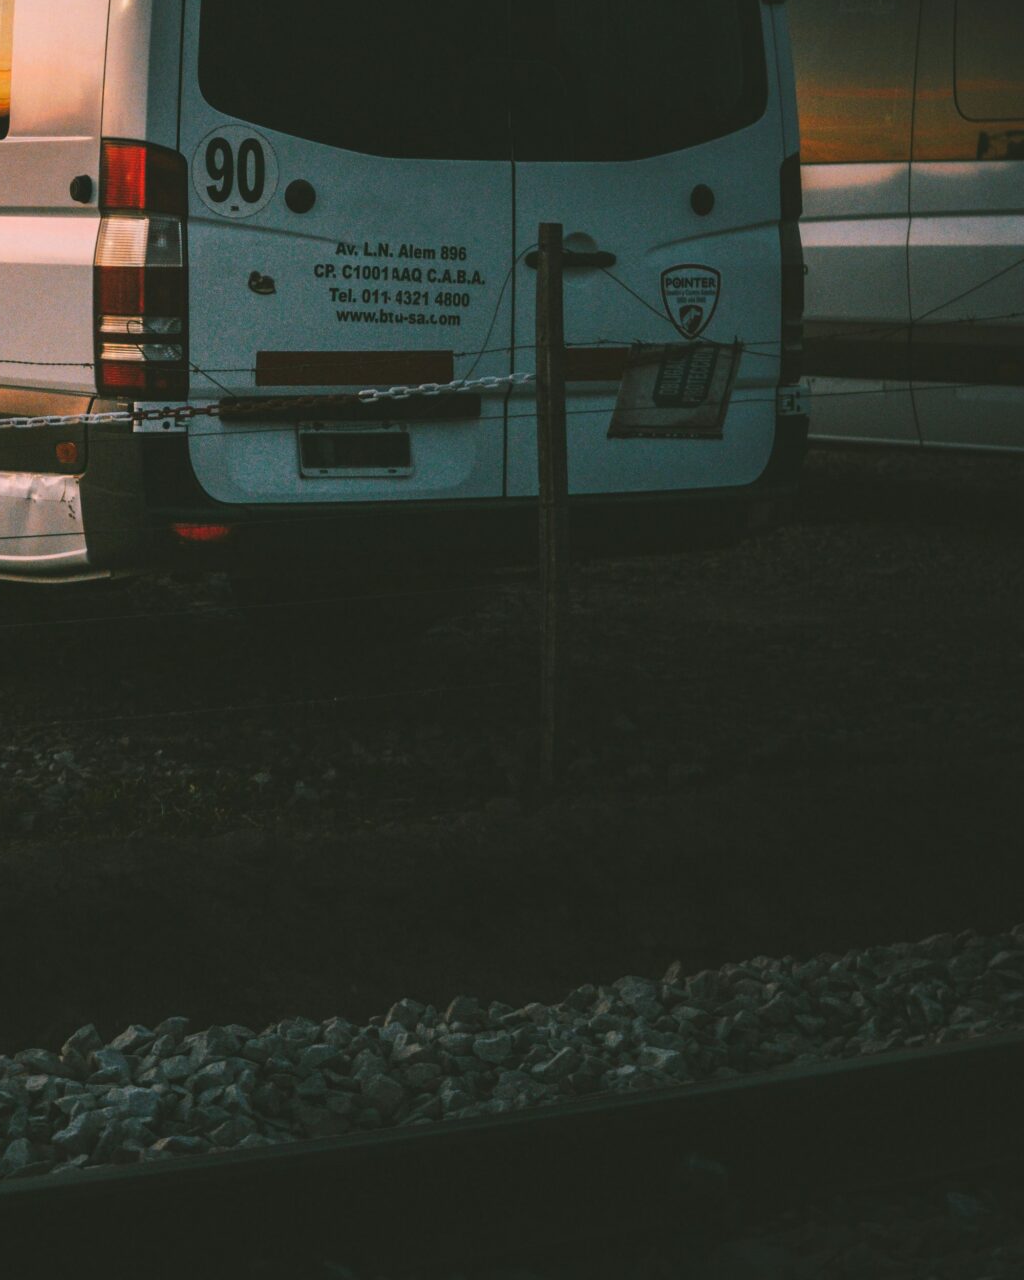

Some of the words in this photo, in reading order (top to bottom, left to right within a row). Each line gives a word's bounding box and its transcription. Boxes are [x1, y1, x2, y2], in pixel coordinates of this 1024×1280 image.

[206, 137, 265, 203] 90
[335, 242, 358, 256] Av.
[363, 242, 393, 257] L.N.
[398, 244, 435, 259] Alem
[440, 246, 467, 260] 896
[314, 264, 337, 278] CP.
[427, 269, 485, 284] C.A.B.A.
[666, 277, 716, 288] POINTER
[329, 288, 356, 302] Tel.
[434, 292, 470, 307] 4800
